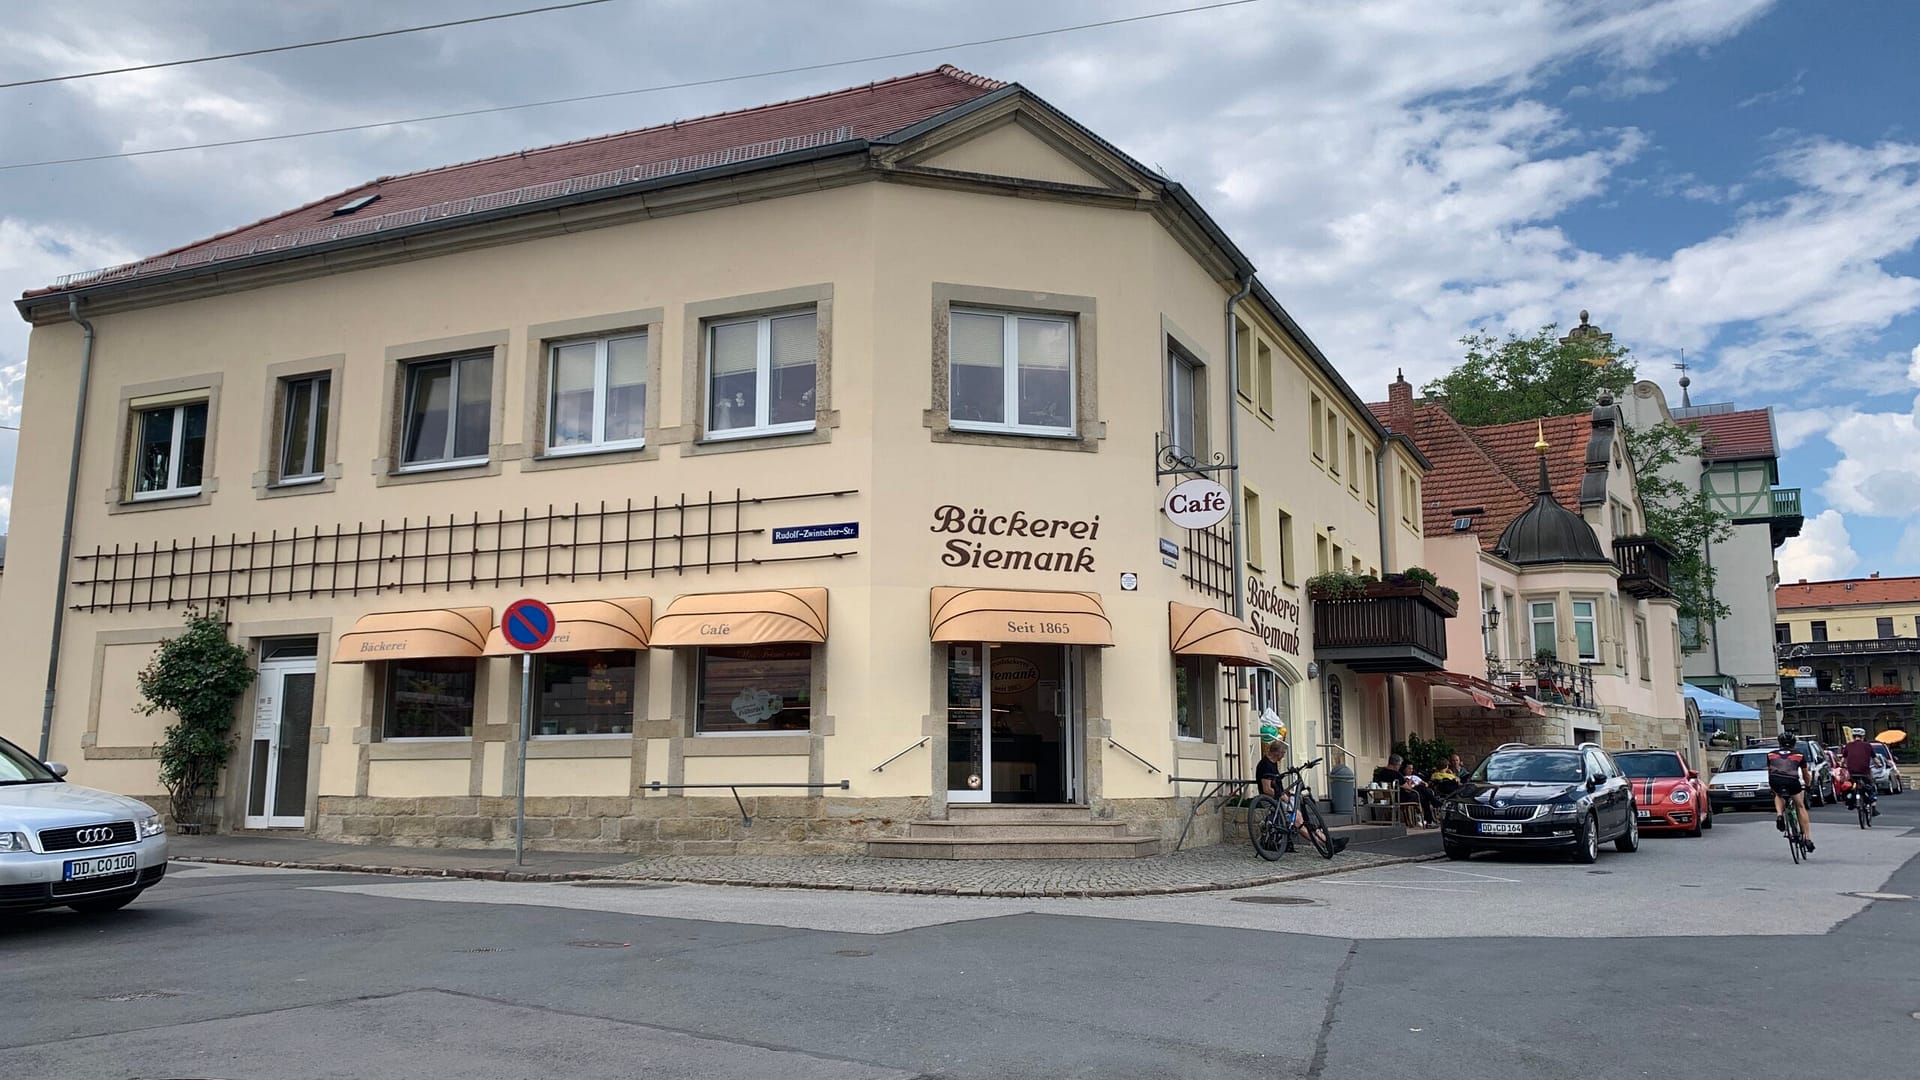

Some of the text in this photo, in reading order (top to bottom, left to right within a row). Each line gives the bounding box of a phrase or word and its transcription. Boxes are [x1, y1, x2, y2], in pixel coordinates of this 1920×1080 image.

[1169, 491, 1226, 514] Café
[930, 504, 1100, 540] Bäckerei
[941, 538, 1096, 573] Siemank
[1246, 575, 1300, 626] Bäckerei
[700, 623, 731, 636] Café
[1007, 620, 1071, 635] Seit 1865
[1250, 610, 1300, 657] Siemank
[360, 639, 408, 652] Bäckerei
[73, 862, 89, 875] DD
